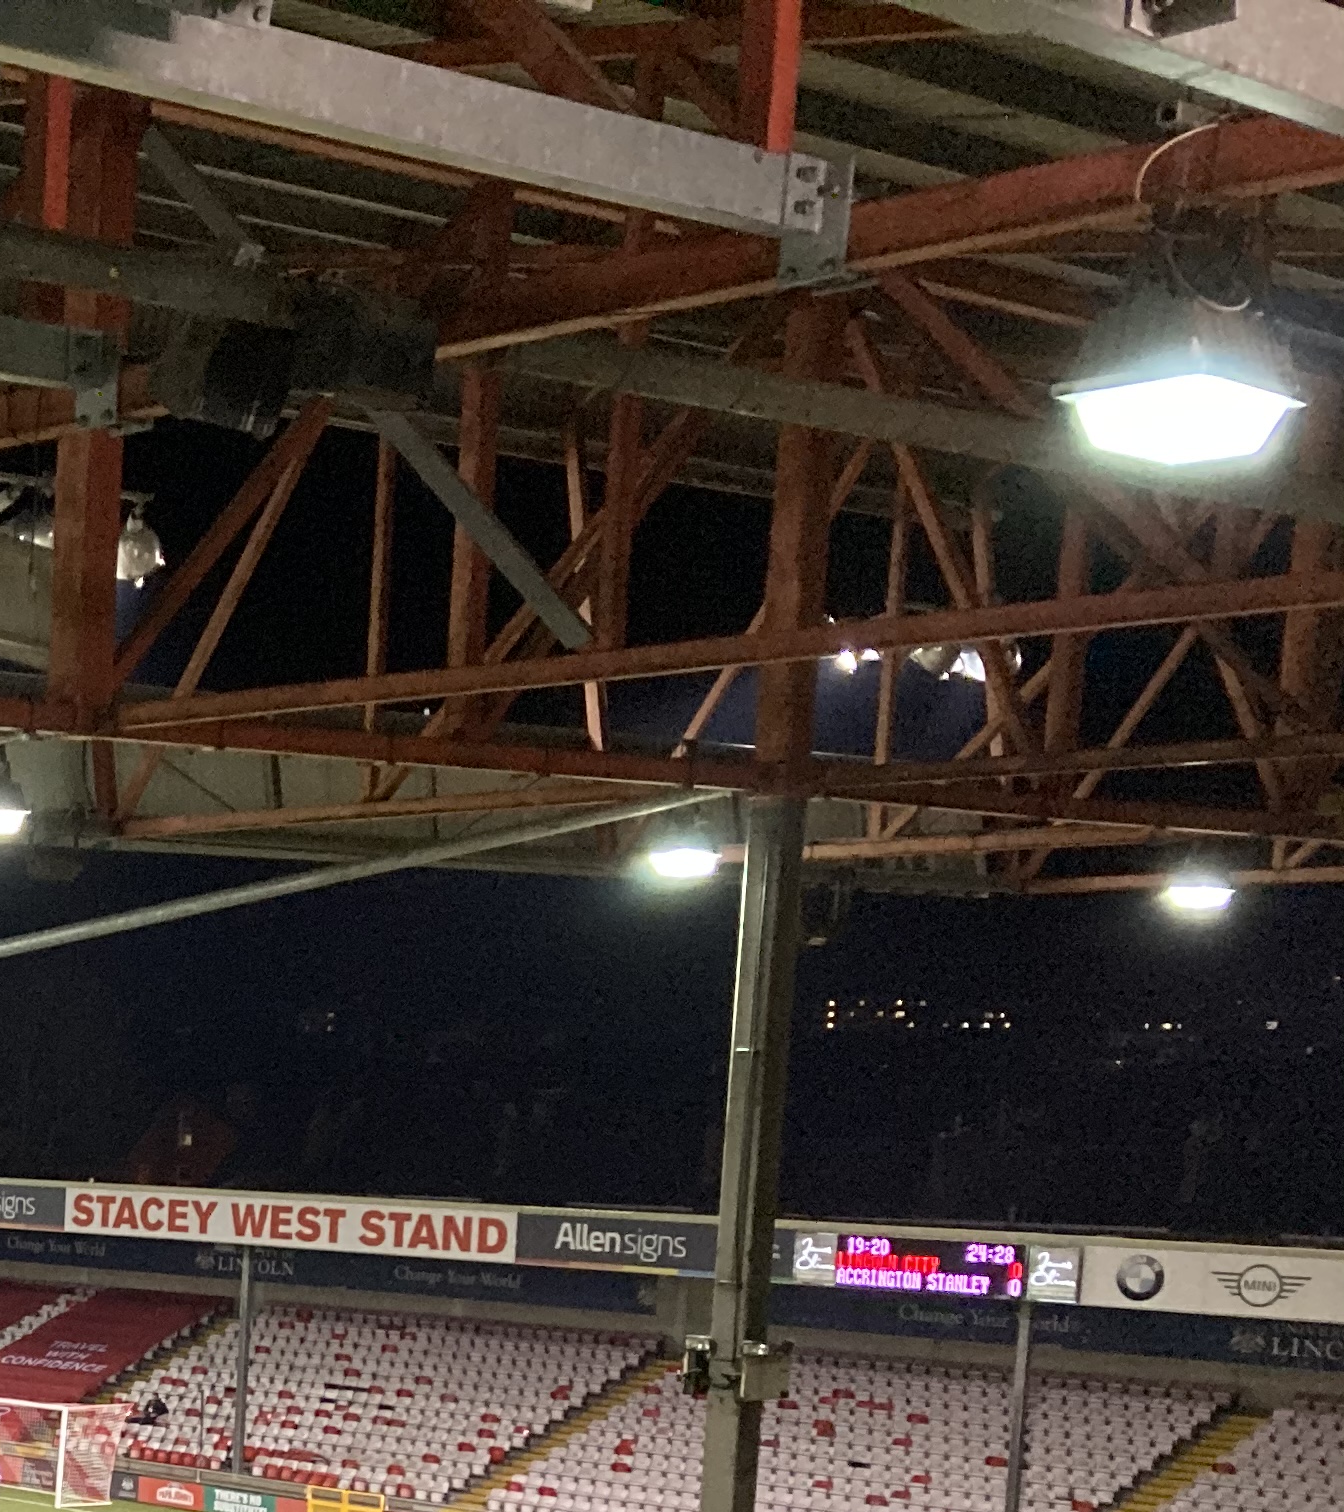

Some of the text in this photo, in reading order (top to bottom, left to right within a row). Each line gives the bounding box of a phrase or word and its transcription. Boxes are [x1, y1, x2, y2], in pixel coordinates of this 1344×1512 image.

[71, 1193, 508, 1255] STACEY WEST STAND
[846, 1237, 891, 1255] 19:20
[964, 1244, 1016, 1264] 24:28
[217, 1257, 295, 1277] LINOLN
[903, 1255, 941, 1274] CITY
[394, 1265, 437, 1285] Change
[836, 1268, 1023, 1297] ACCRINGTON STANLEY 0
[1243, 1280, 1277, 1292] MINI
[899, 1302, 964, 1327] Change
[44, 1351, 91, 1360] WITH
[49, 1341, 109, 1353] TRAVEL
[0, 1355, 109, 1373] CONFIDENCE
